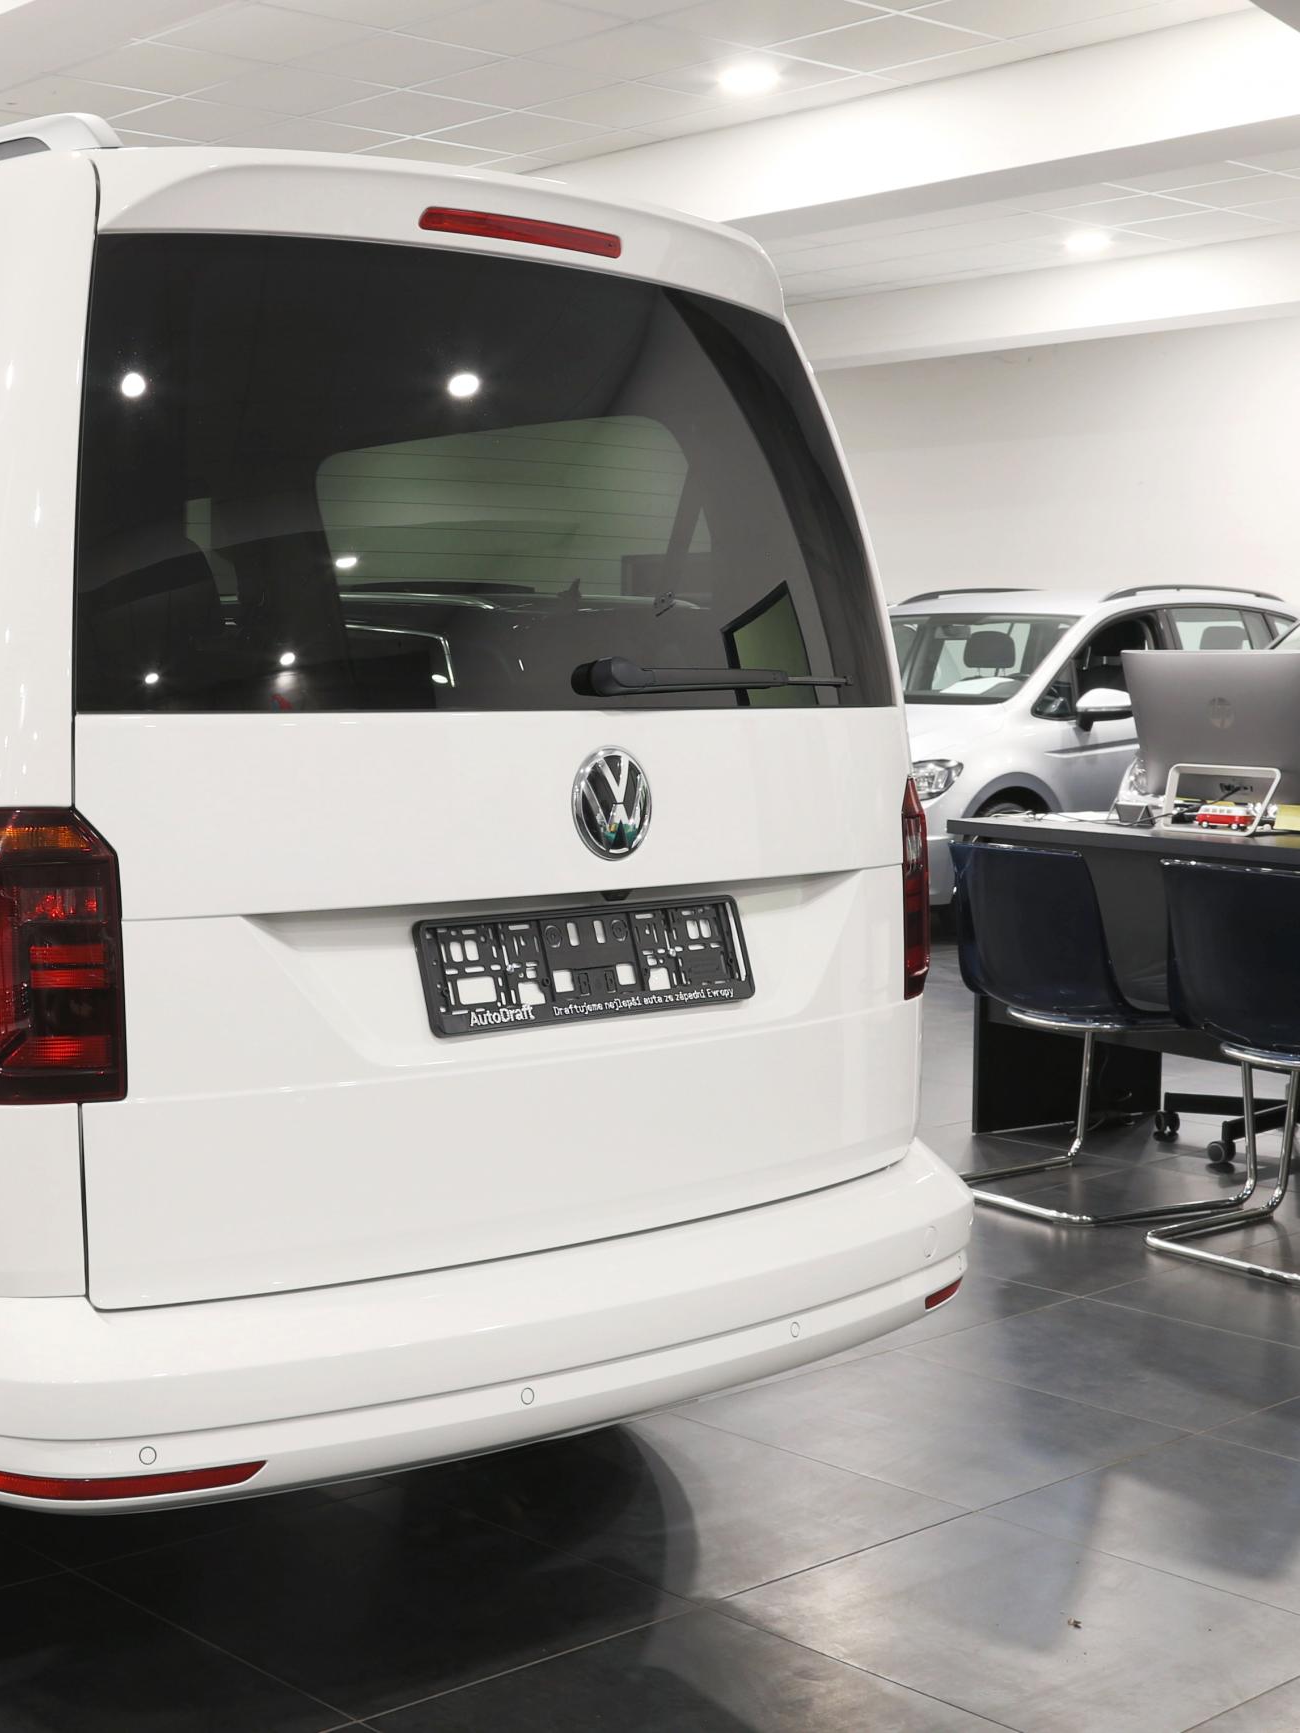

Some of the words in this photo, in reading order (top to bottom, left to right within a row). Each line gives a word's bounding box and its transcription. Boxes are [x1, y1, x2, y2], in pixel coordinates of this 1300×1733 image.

[553, 1001, 603, 1016] Draftujeme
[604, 996, 642, 1011] nejlepší
[643, 994, 663, 1005] auta
[675, 989, 706, 1003] západní
[706, 987, 734, 999] Evropy
[469, 1004, 536, 1027] AutoDraft
